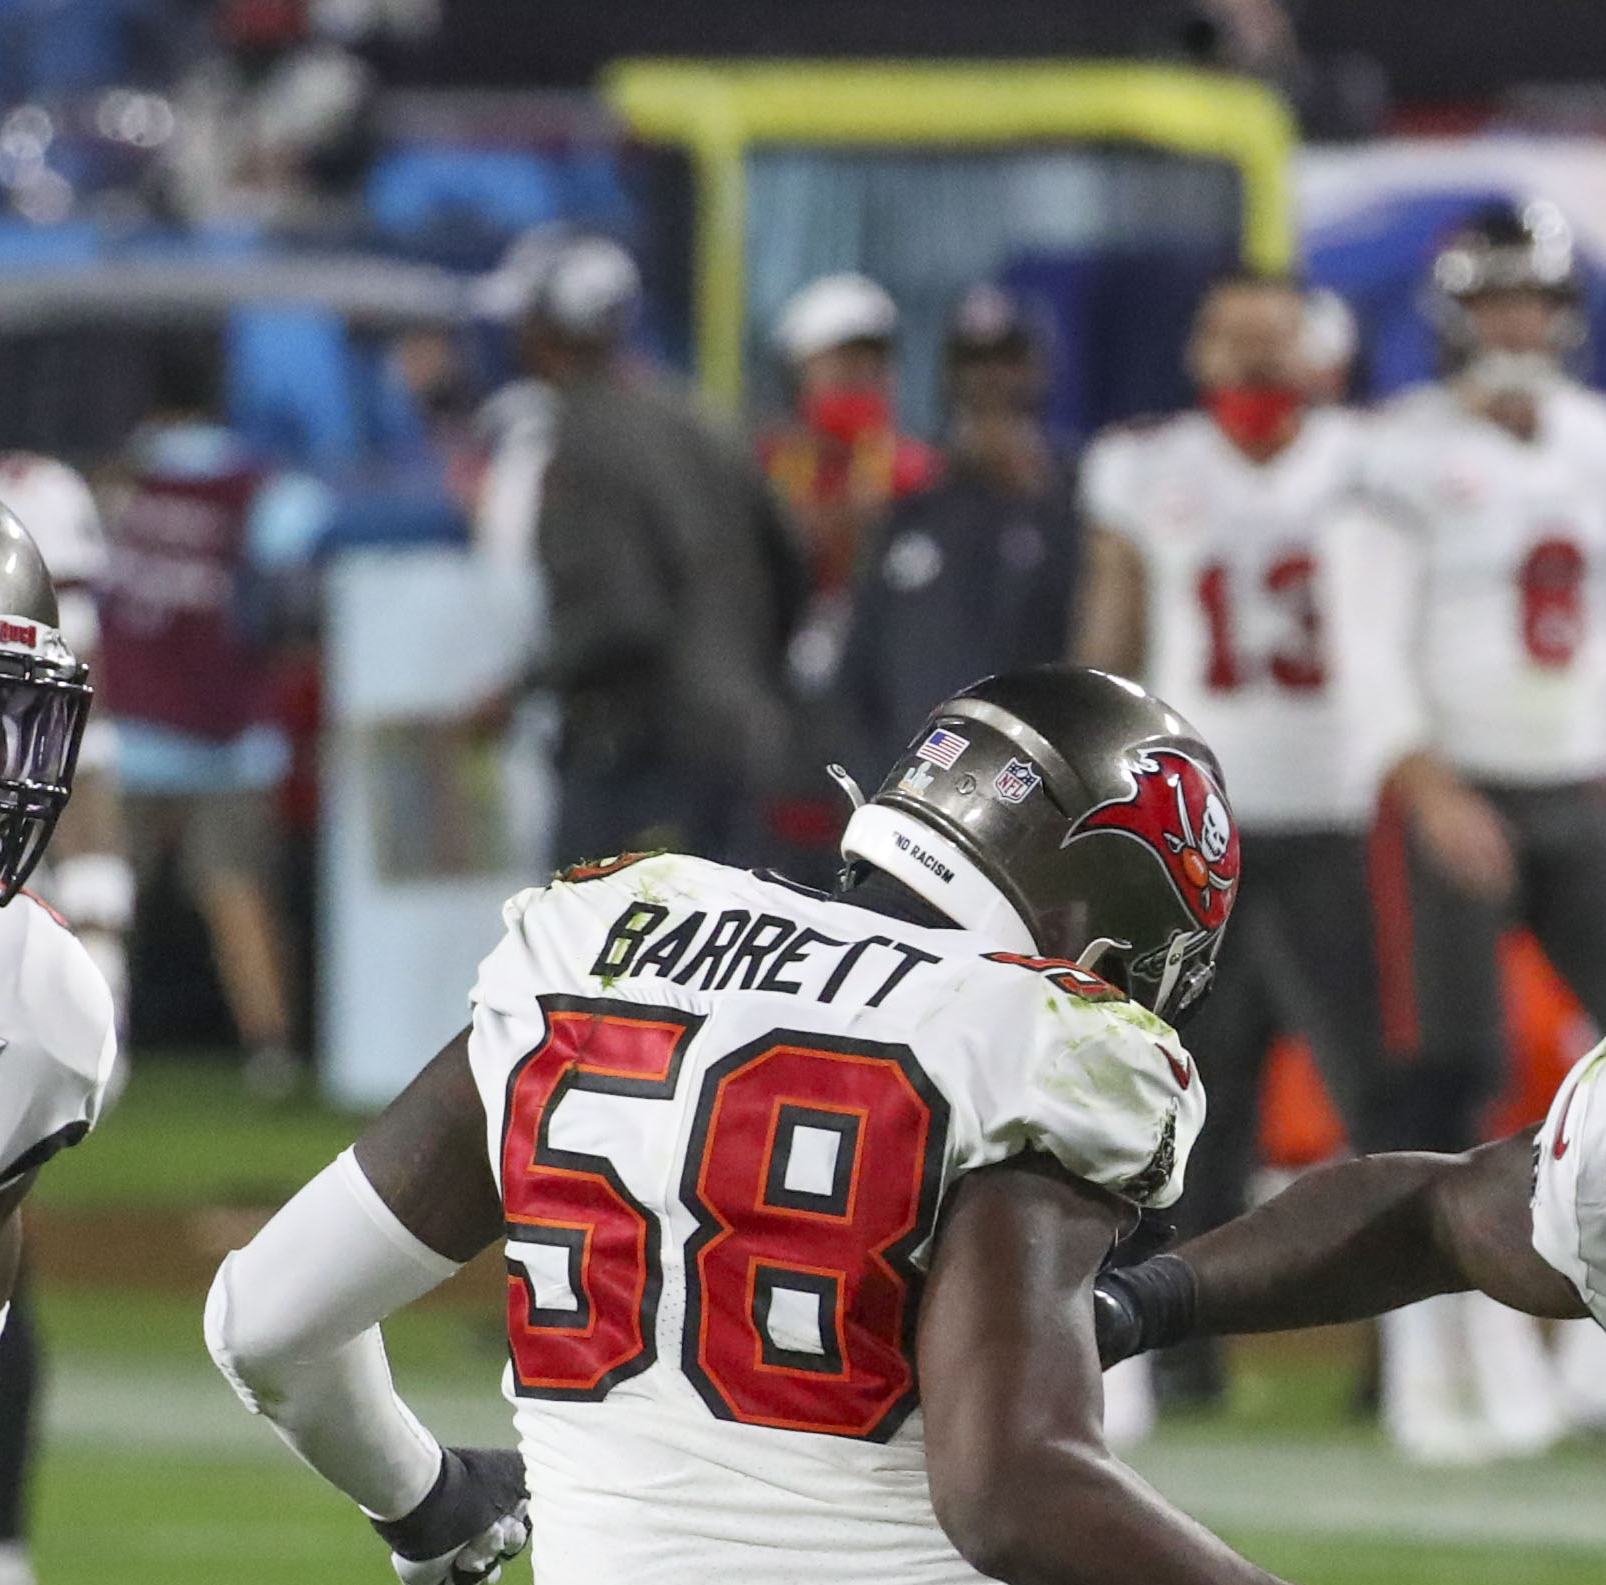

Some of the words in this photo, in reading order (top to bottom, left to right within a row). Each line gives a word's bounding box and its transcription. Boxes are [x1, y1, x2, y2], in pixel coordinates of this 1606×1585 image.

[997, 769, 1026, 800] NFL
[909, 844, 956, 885] RACISM
[588, 901, 941, 1008] BARRETT
[500, 993, 951, 1444] 58
